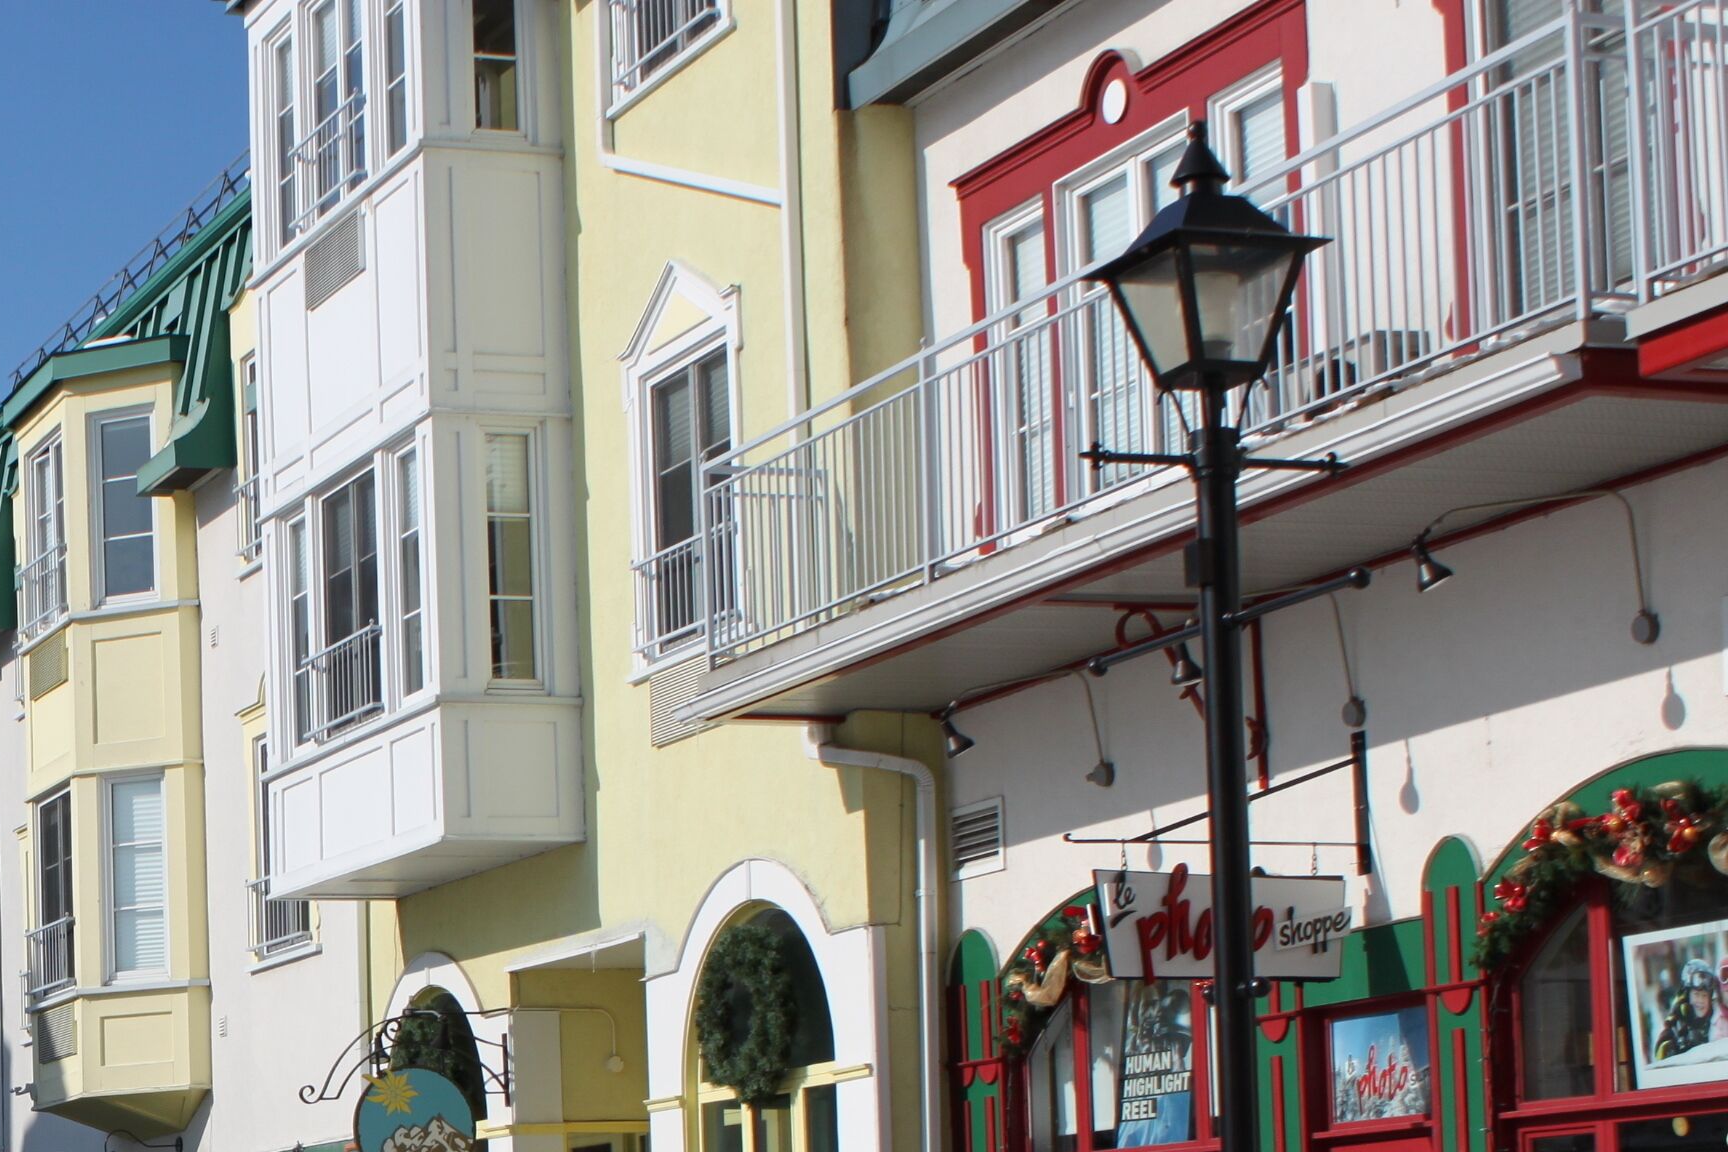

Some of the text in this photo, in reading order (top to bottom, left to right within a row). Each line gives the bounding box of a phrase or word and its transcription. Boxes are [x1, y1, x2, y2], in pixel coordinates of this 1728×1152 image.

[1114, 862, 1351, 985] le phoo shoppe
[1125, 1051, 1171, 1075] HUMAN
[1123, 1071, 1190, 1098] HIGHLIGHT
[1357, 1044, 1408, 1114] photo
[1122, 1100, 1156, 1120] REEL
